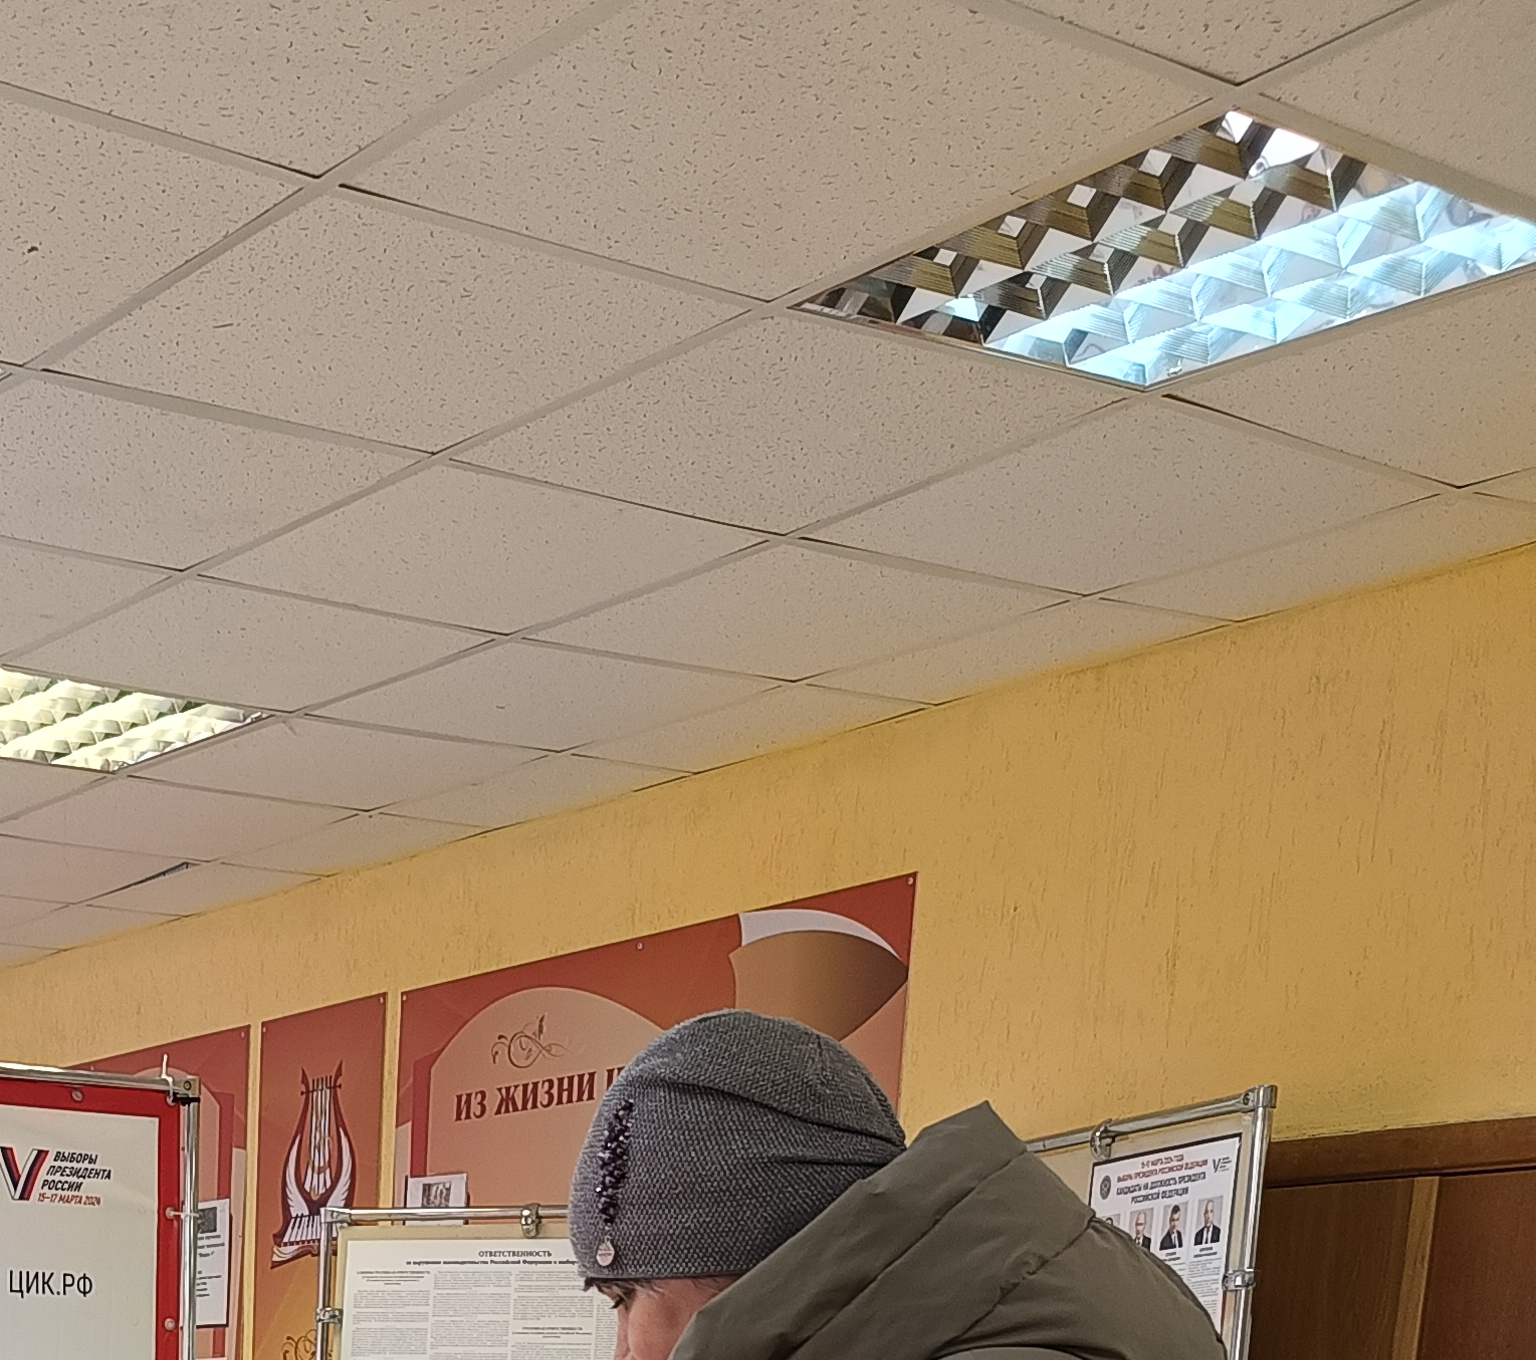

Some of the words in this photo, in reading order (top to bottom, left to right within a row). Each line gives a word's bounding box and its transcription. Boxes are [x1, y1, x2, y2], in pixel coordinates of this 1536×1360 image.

[454, 1090, 487, 1121] ИЗ
[494, 1071, 597, 1115] ЖИЗНИ
[52, 1151, 99, 1164] ВЫБОРЫ
[47, 1165, 111, 1180] ПРЕЗИДЕНТА
[41, 1179, 83, 1192] РОССИИ
[10, 1270, 92, 1299] ЦИК.РФ
